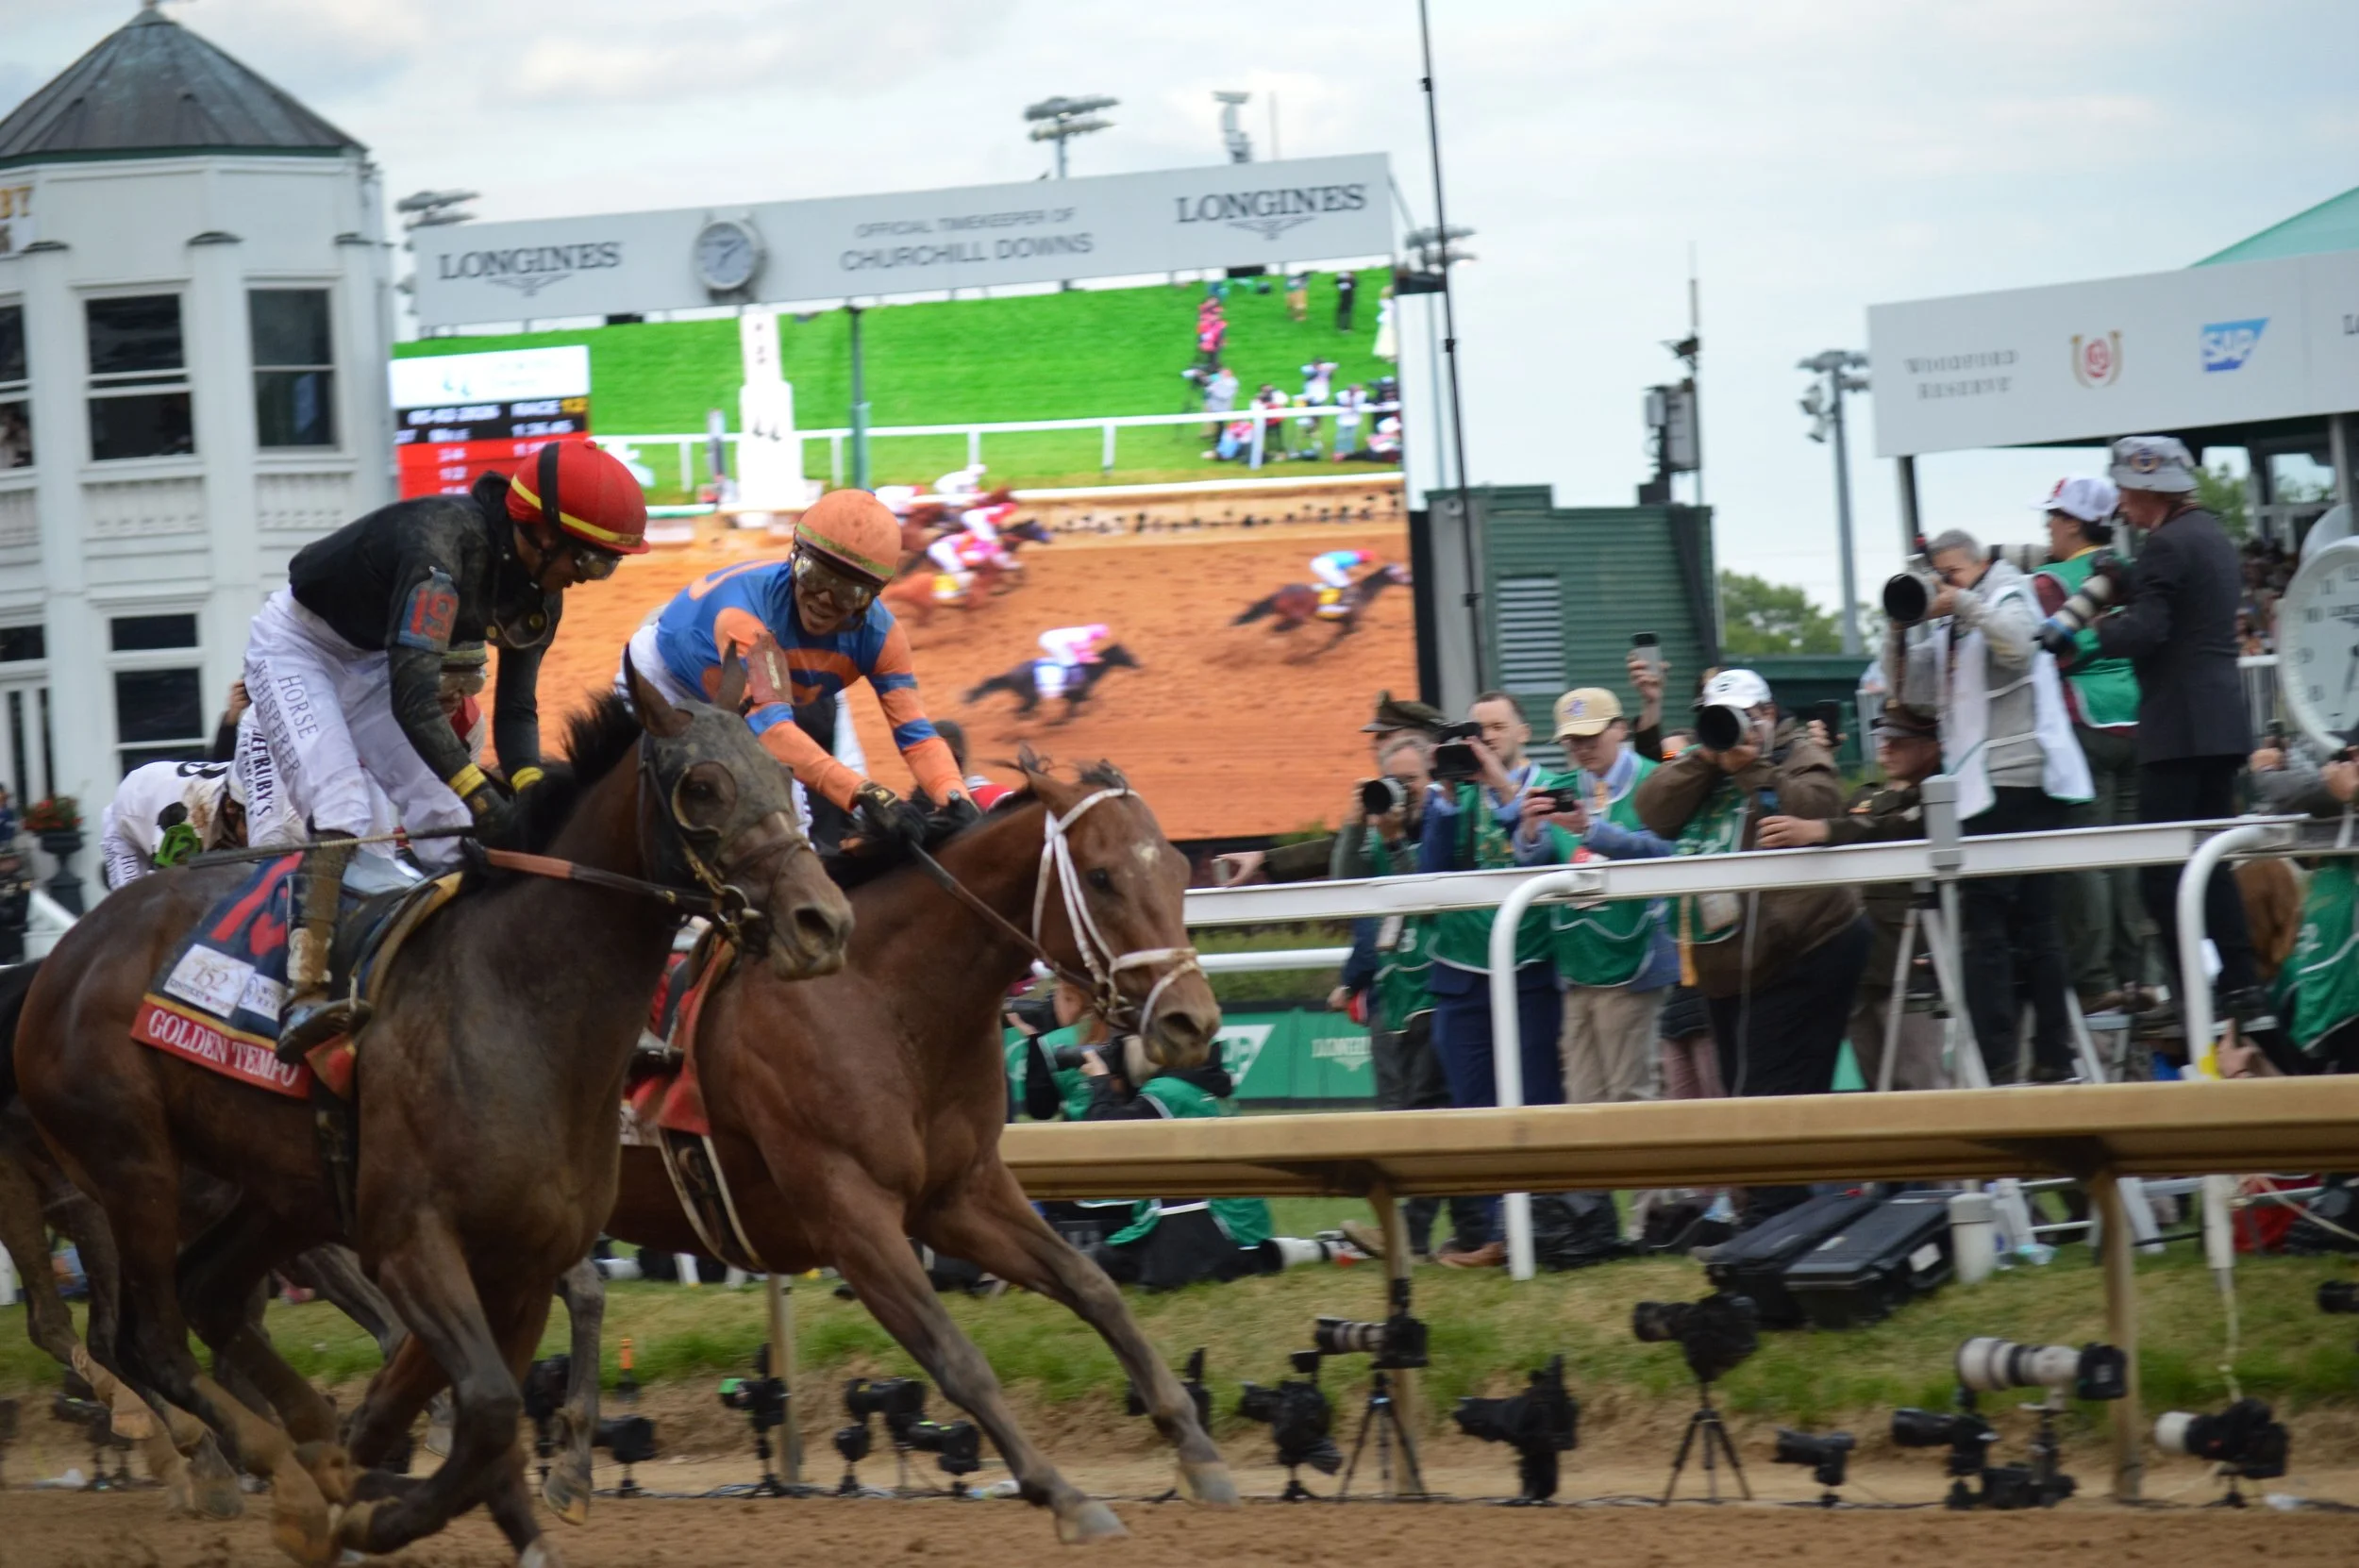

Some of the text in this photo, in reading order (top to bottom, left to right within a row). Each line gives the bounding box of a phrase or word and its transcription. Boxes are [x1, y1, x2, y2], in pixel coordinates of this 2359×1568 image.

[854, 207, 1076, 238] OFFICIAL TIMEKEEPER OF
[1176, 184, 1365, 224] LONGINES
[438, 242, 622, 280] LONGINES
[839, 232, 1094, 272] CHURCHILL DOWNS
[1904, 349, 2019, 375] WOODFORD
[510, 399, 560, 417] RACE
[1917, 376, 2012, 400] RESERVE
[410, 588, 459, 640] 19
[252, 659, 301, 776] WHISPERER
[277, 675, 319, 739] HORSE
[253, 758, 274, 817] RUBY'S
[164, 829, 194, 861] 12
[148, 1009, 227, 1064] GOLDEN
